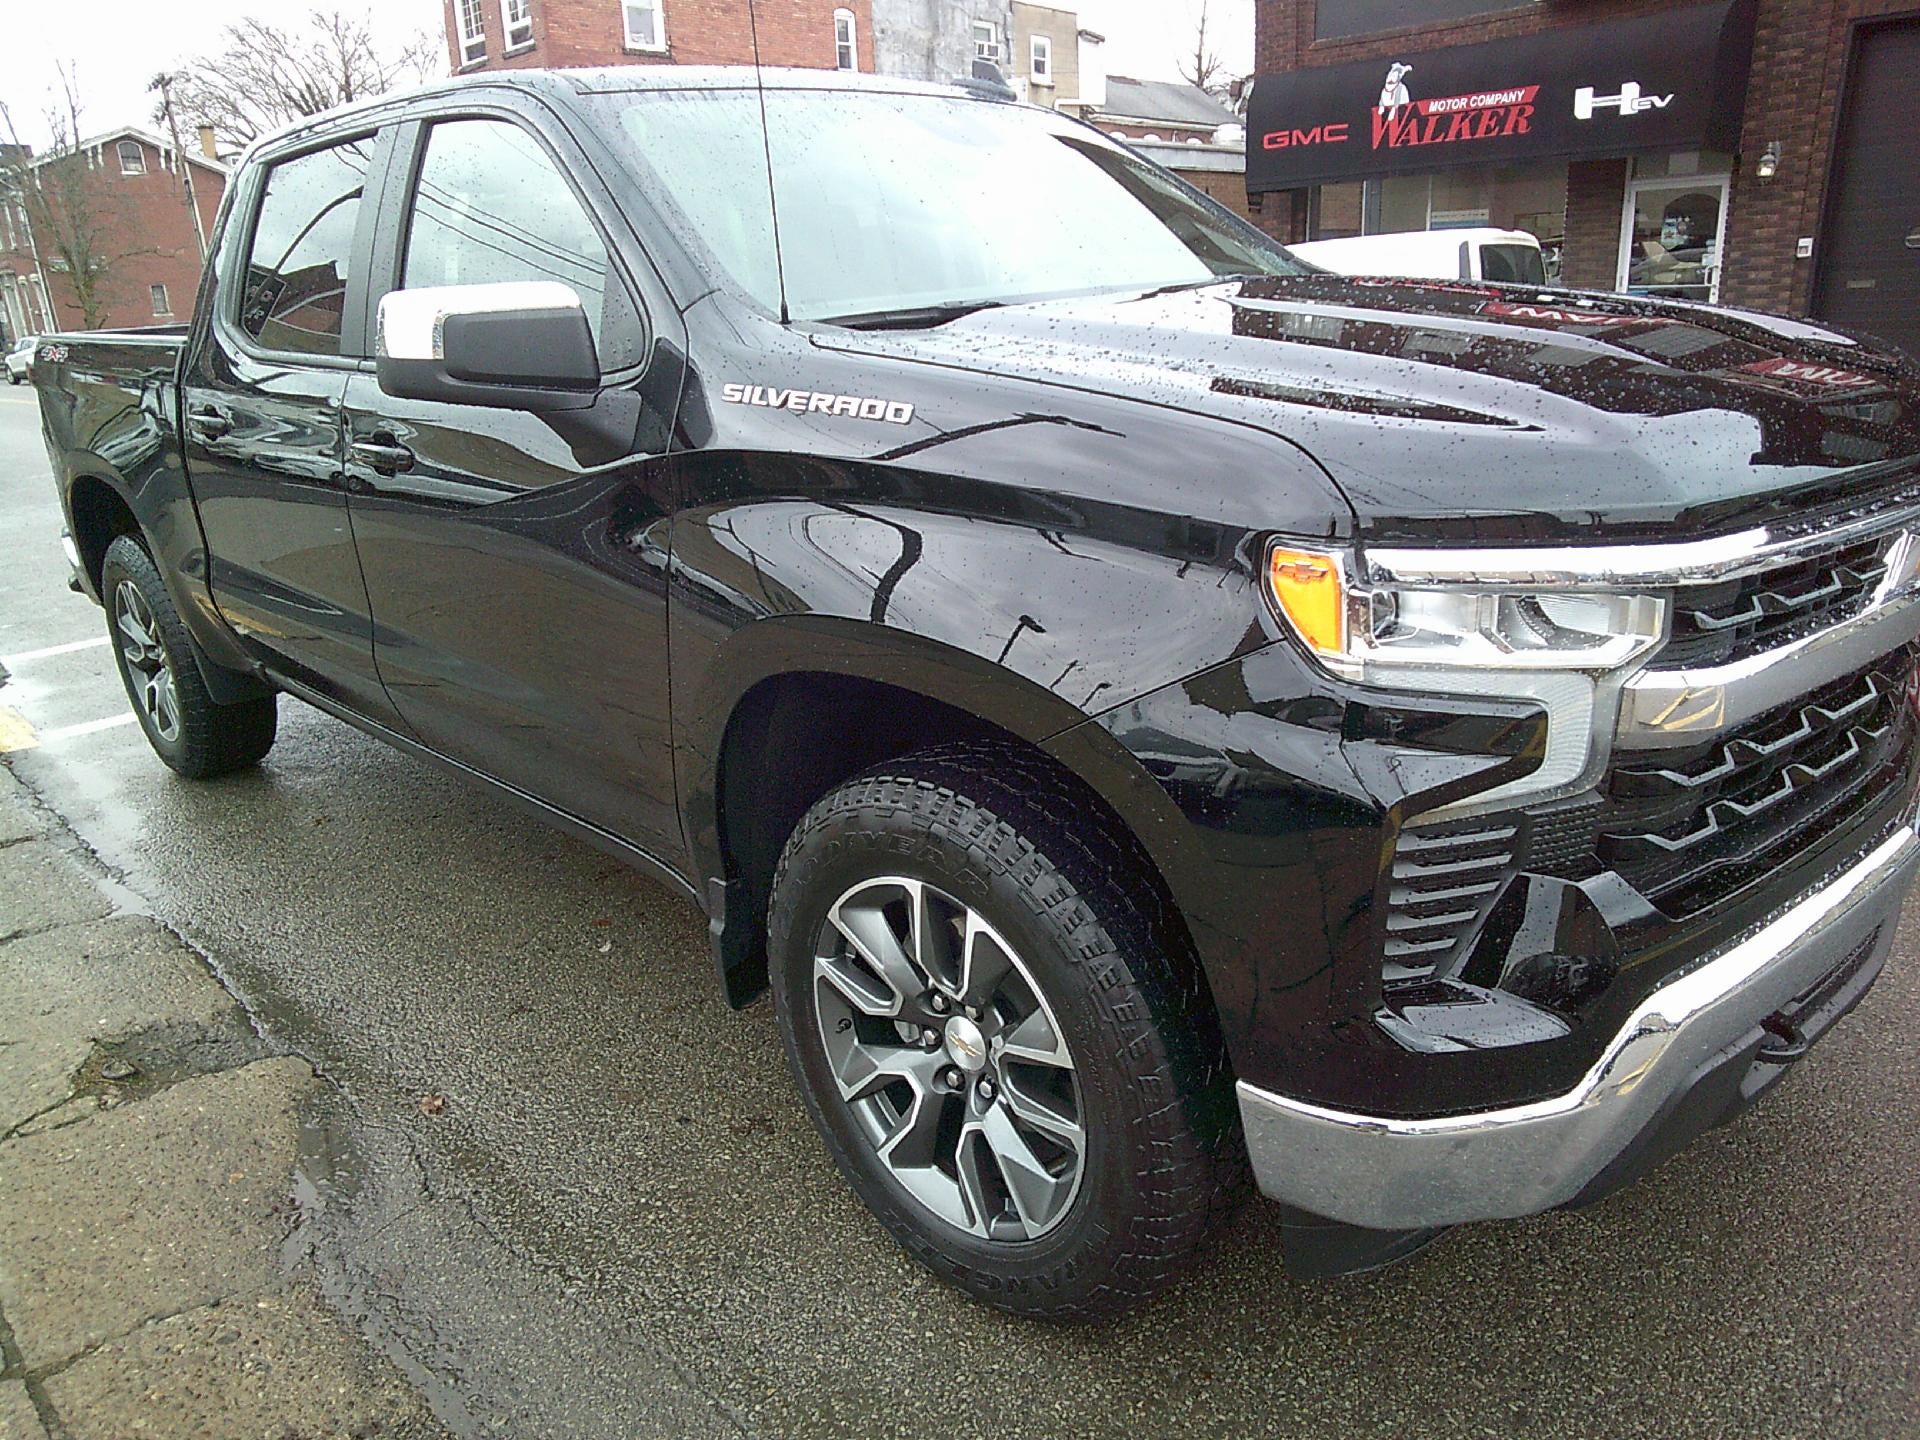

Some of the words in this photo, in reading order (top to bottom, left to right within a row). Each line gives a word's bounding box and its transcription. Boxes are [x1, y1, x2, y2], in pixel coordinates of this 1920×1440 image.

[1429, 97, 1467, 112] MOTOR
[1470, 89, 1525, 108] COMPANY
[1263, 123, 1349, 149] GMC
[1371, 102, 1535, 149] WALKER
[721, 383, 915, 425] SILVERADO
